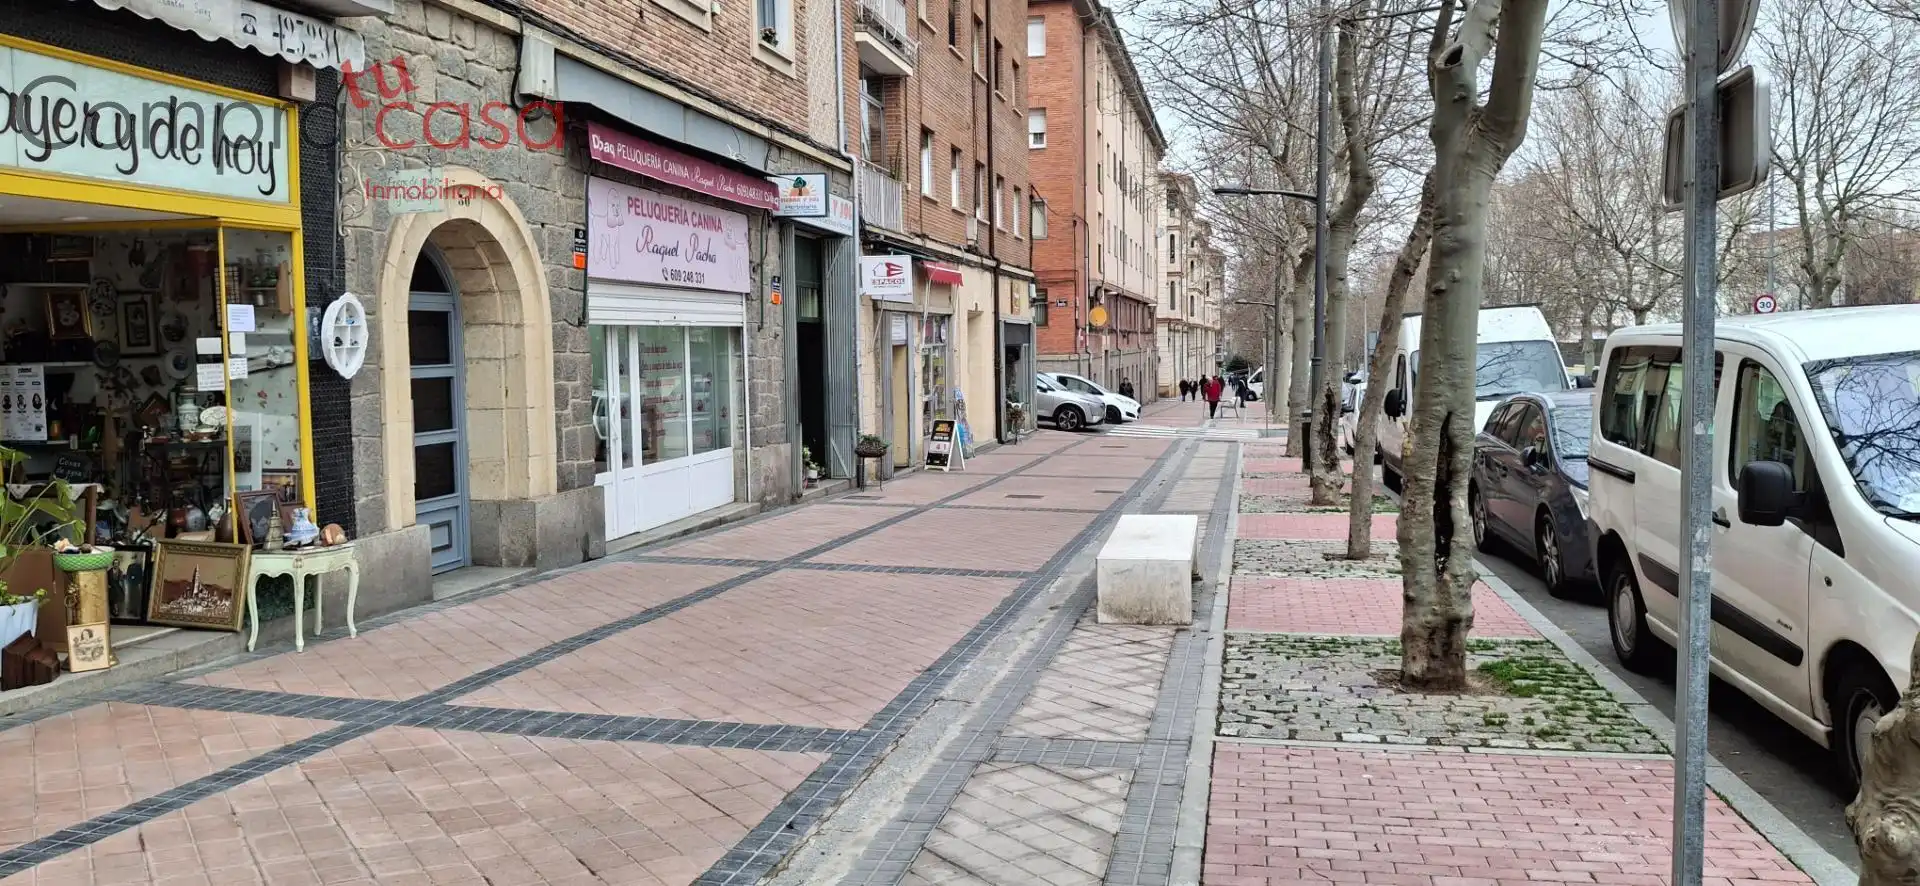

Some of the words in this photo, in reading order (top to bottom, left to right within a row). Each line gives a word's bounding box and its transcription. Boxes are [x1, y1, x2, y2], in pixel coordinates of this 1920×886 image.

[115, 111, 139, 175] y
[150, 95, 201, 165] de
[212, 101, 276, 196] hoy
[616, 141, 662, 170] PELUQUERÍA
[663, 159, 690, 179] CANINA
[627, 196, 690, 227] PELUQUERÍA
[691, 211, 723, 233] CANINA
[636, 225, 680, 262] Raquel
[670, 268, 682, 282] 609
[683, 270, 694, 283] 248
[695, 272, 705, 284] 331
[1759, 301, 1772, 309] 30
